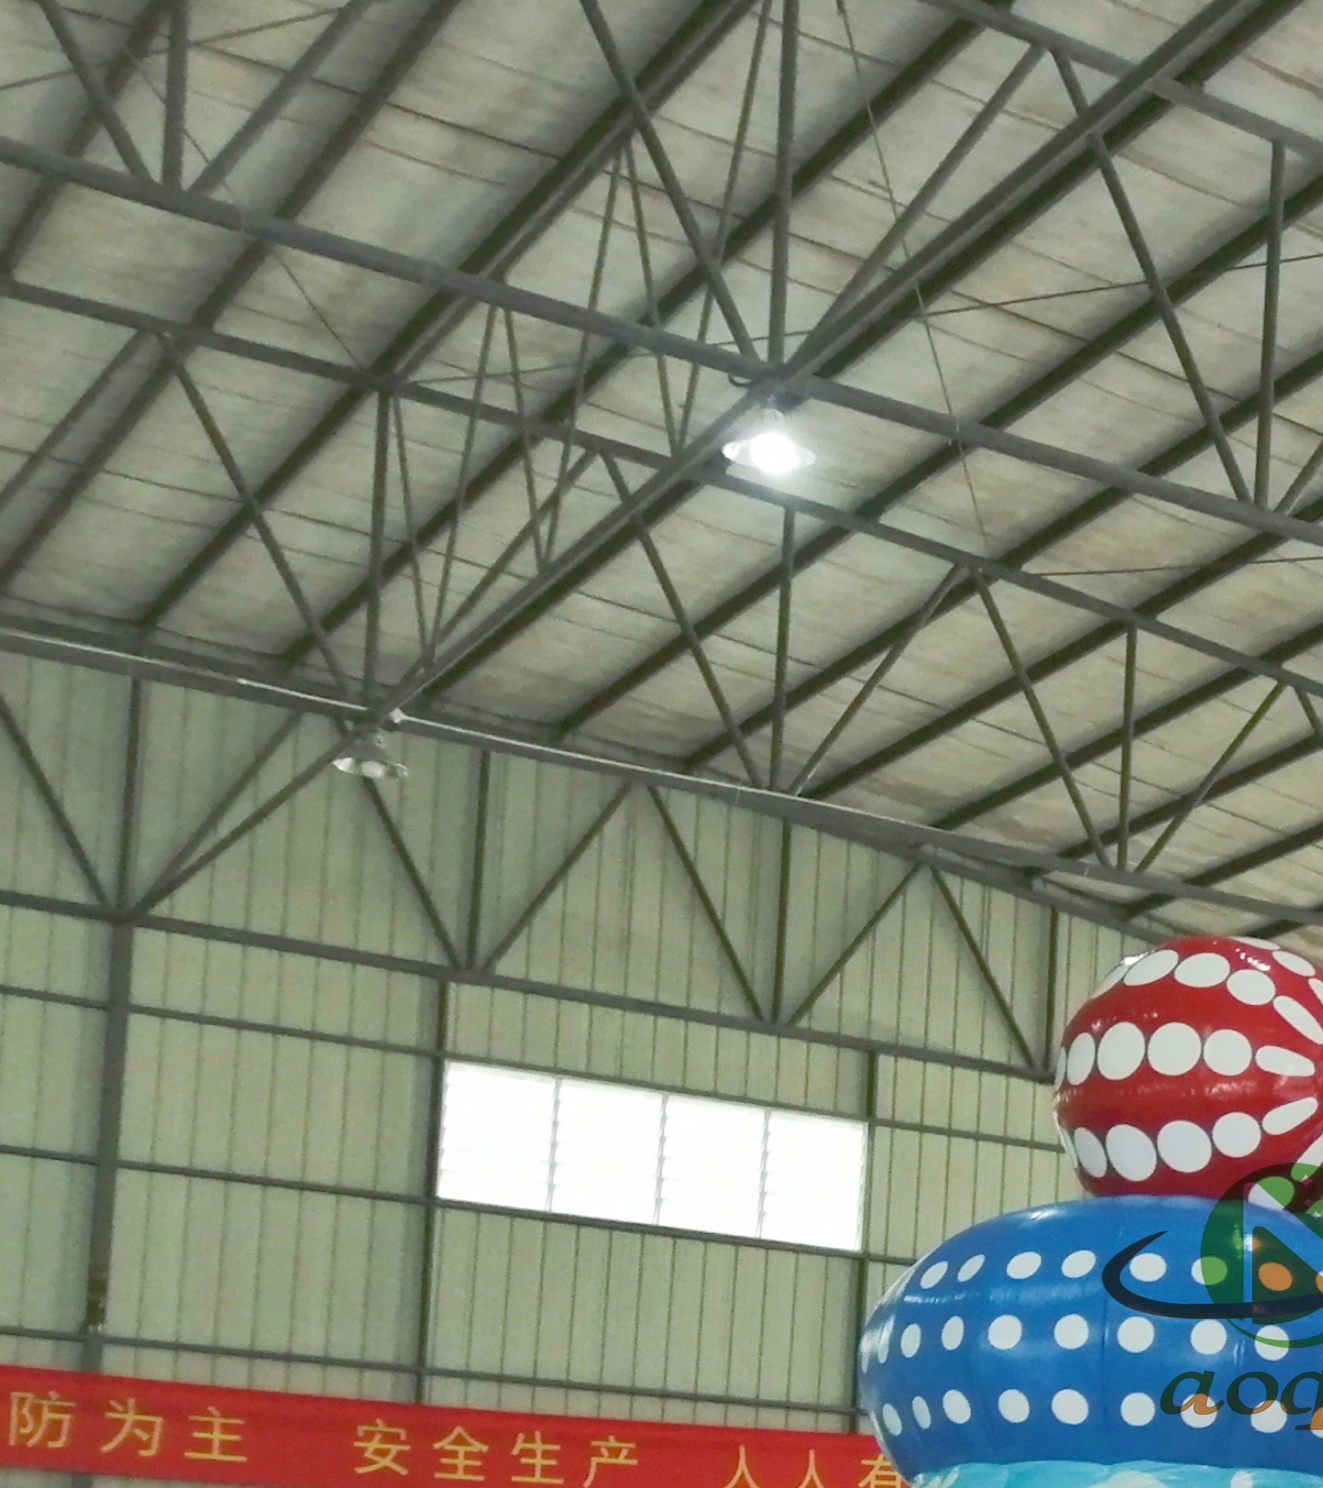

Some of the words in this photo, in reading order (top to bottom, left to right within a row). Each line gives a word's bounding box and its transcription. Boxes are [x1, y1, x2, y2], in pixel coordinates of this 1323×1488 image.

[8, 1390, 248, 1463] 防为主
[353, 1417, 639, 1488] 安全生产
